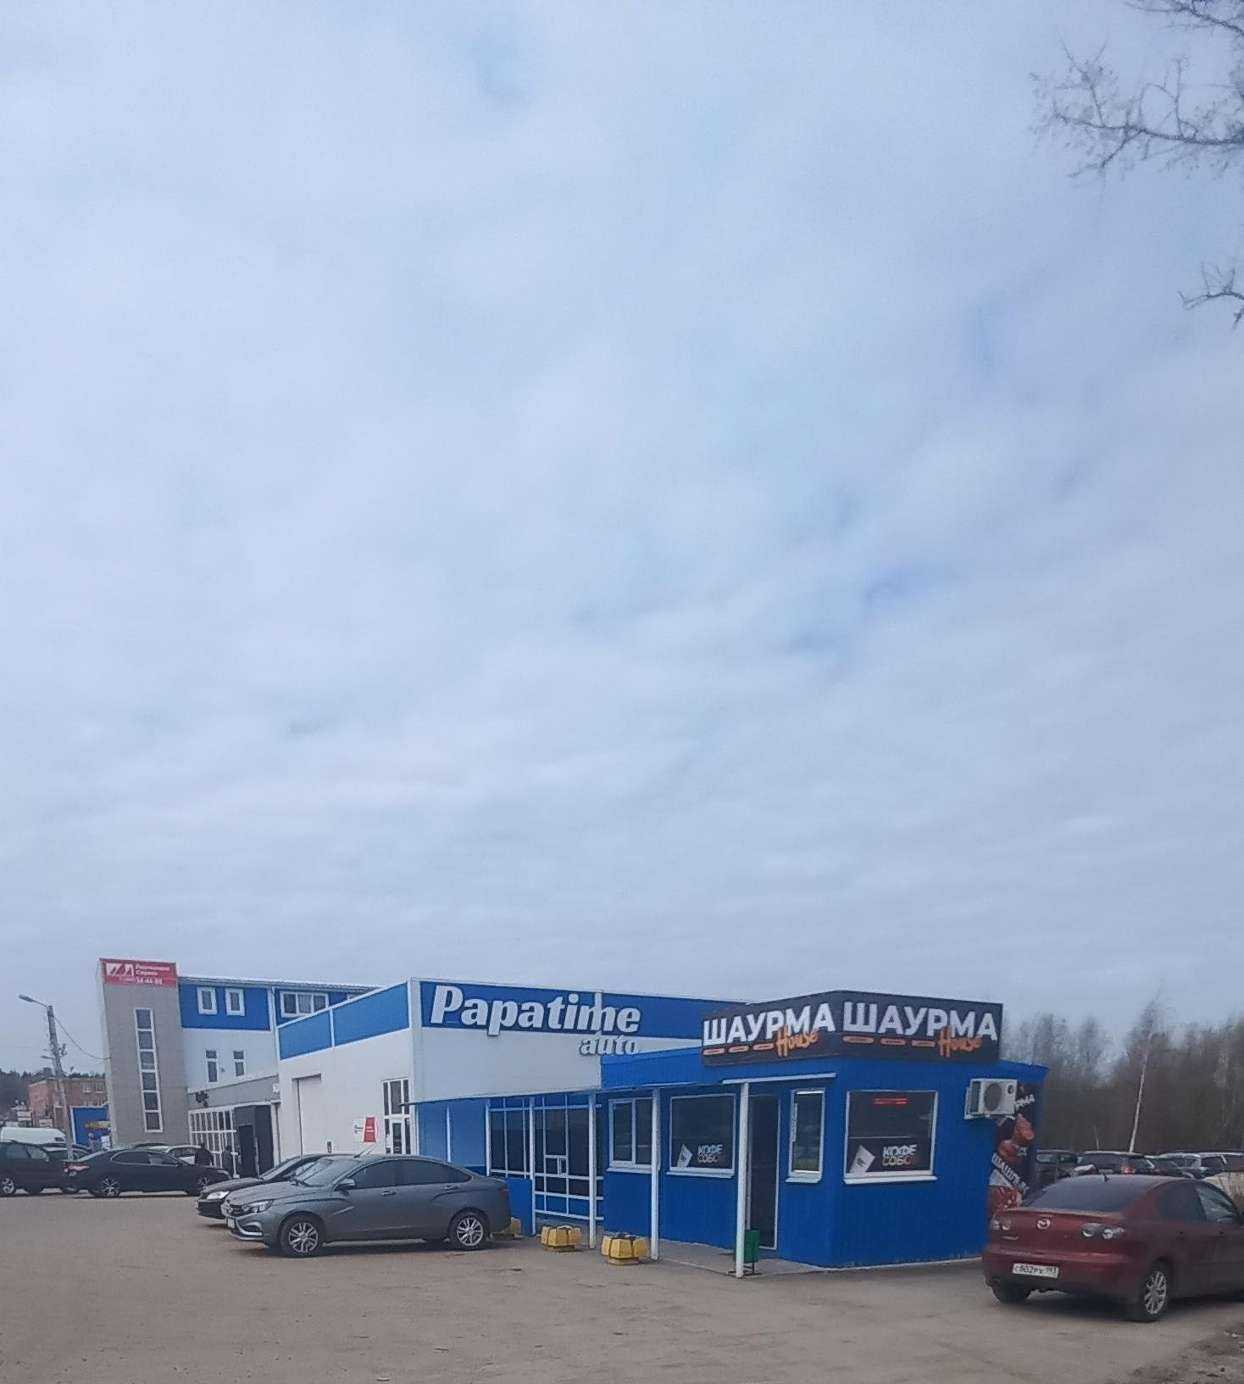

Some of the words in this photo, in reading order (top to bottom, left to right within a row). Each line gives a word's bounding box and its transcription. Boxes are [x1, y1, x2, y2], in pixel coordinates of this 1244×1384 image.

[430, 985, 641, 1036] Papatime
[702, 1002, 836, 1046] ШАУРМА
[842, 1001, 998, 1041] ШАУРМА
[579, 1034, 640, 1056] auto
[883, 1144, 917, 1157] КОФЕ
